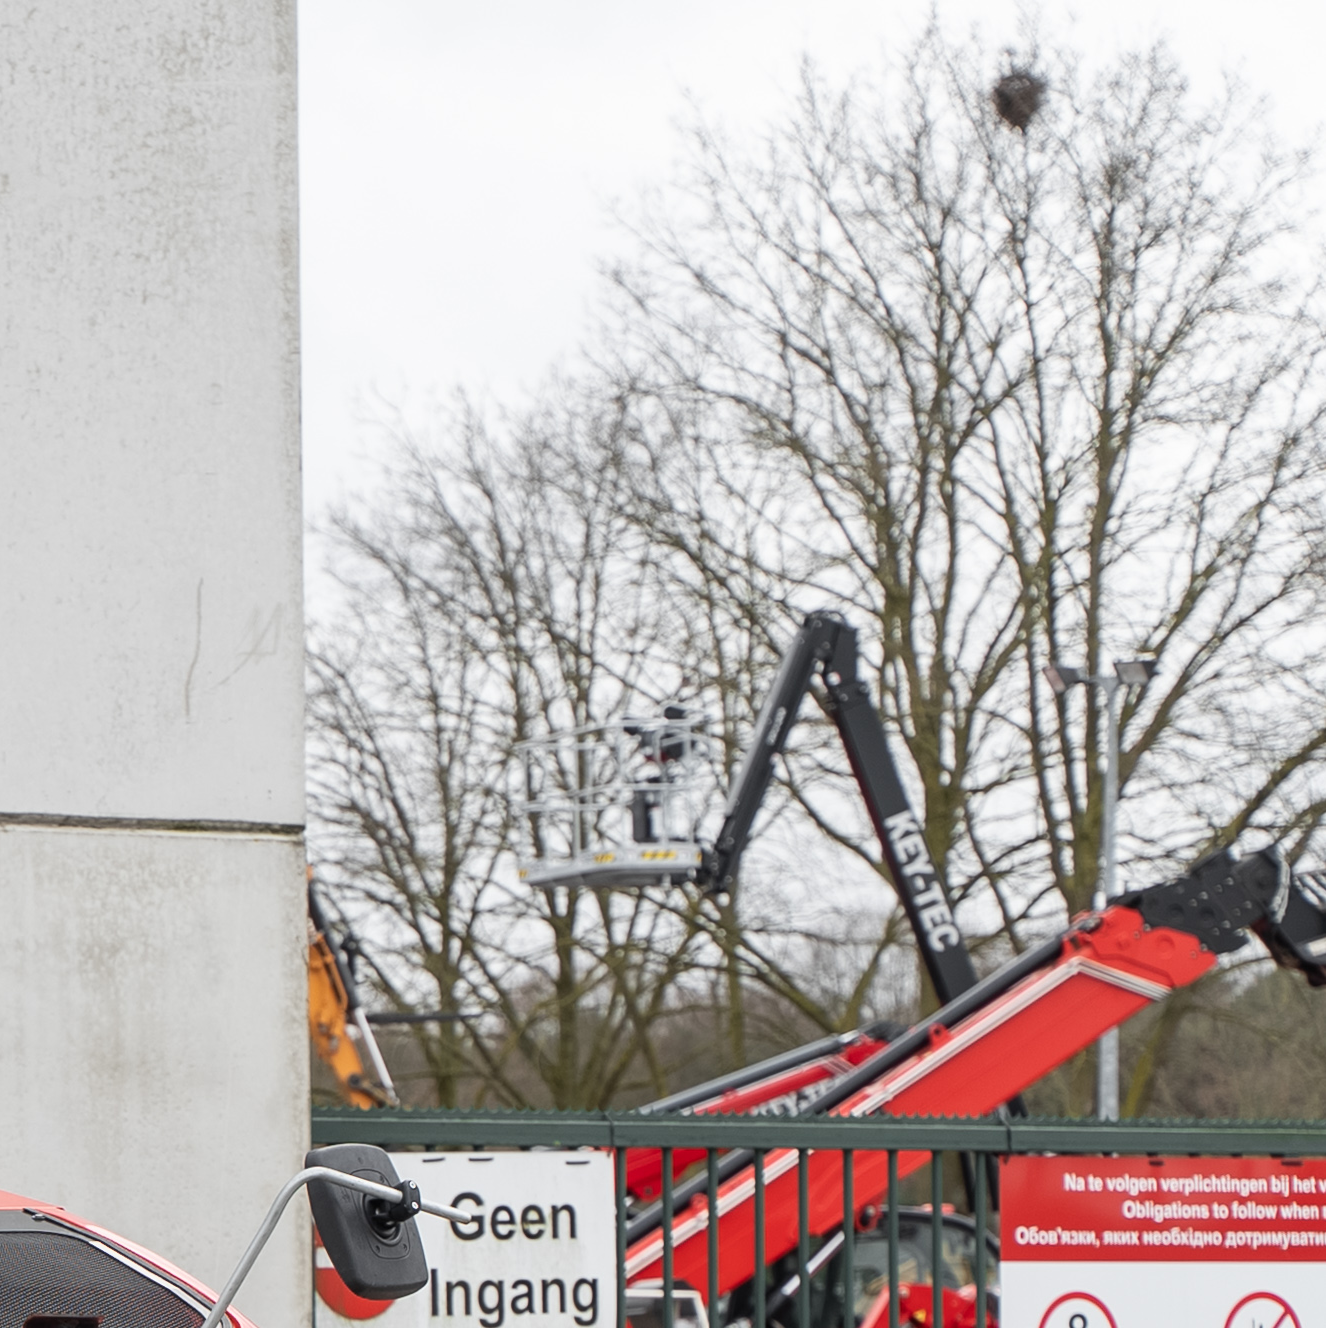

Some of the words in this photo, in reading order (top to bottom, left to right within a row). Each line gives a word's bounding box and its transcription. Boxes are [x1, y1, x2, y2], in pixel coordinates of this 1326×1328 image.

[884, 809, 960, 953] KEY-TEC
[1063, 1172, 1085, 1192] Na
[1087, 1173, 1104, 1192] te
[1105, 1173, 1157, 1196] volgen
[1160, 1173, 1268, 1197] verplichtingen
[1270, 1174, 1289, 1197] bij
[1292, 1174, 1316, 1194] het
[450, 1192, 577, 1241] Geen
[1122, 1199, 1209, 1223] Obligations
[1212, 1201, 1229, 1219] to
[1231, 1200, 1277, 1220] follow
[1279, 1201, 1319, 1220] when
[430, 1268, 598, 1328] Ingang
